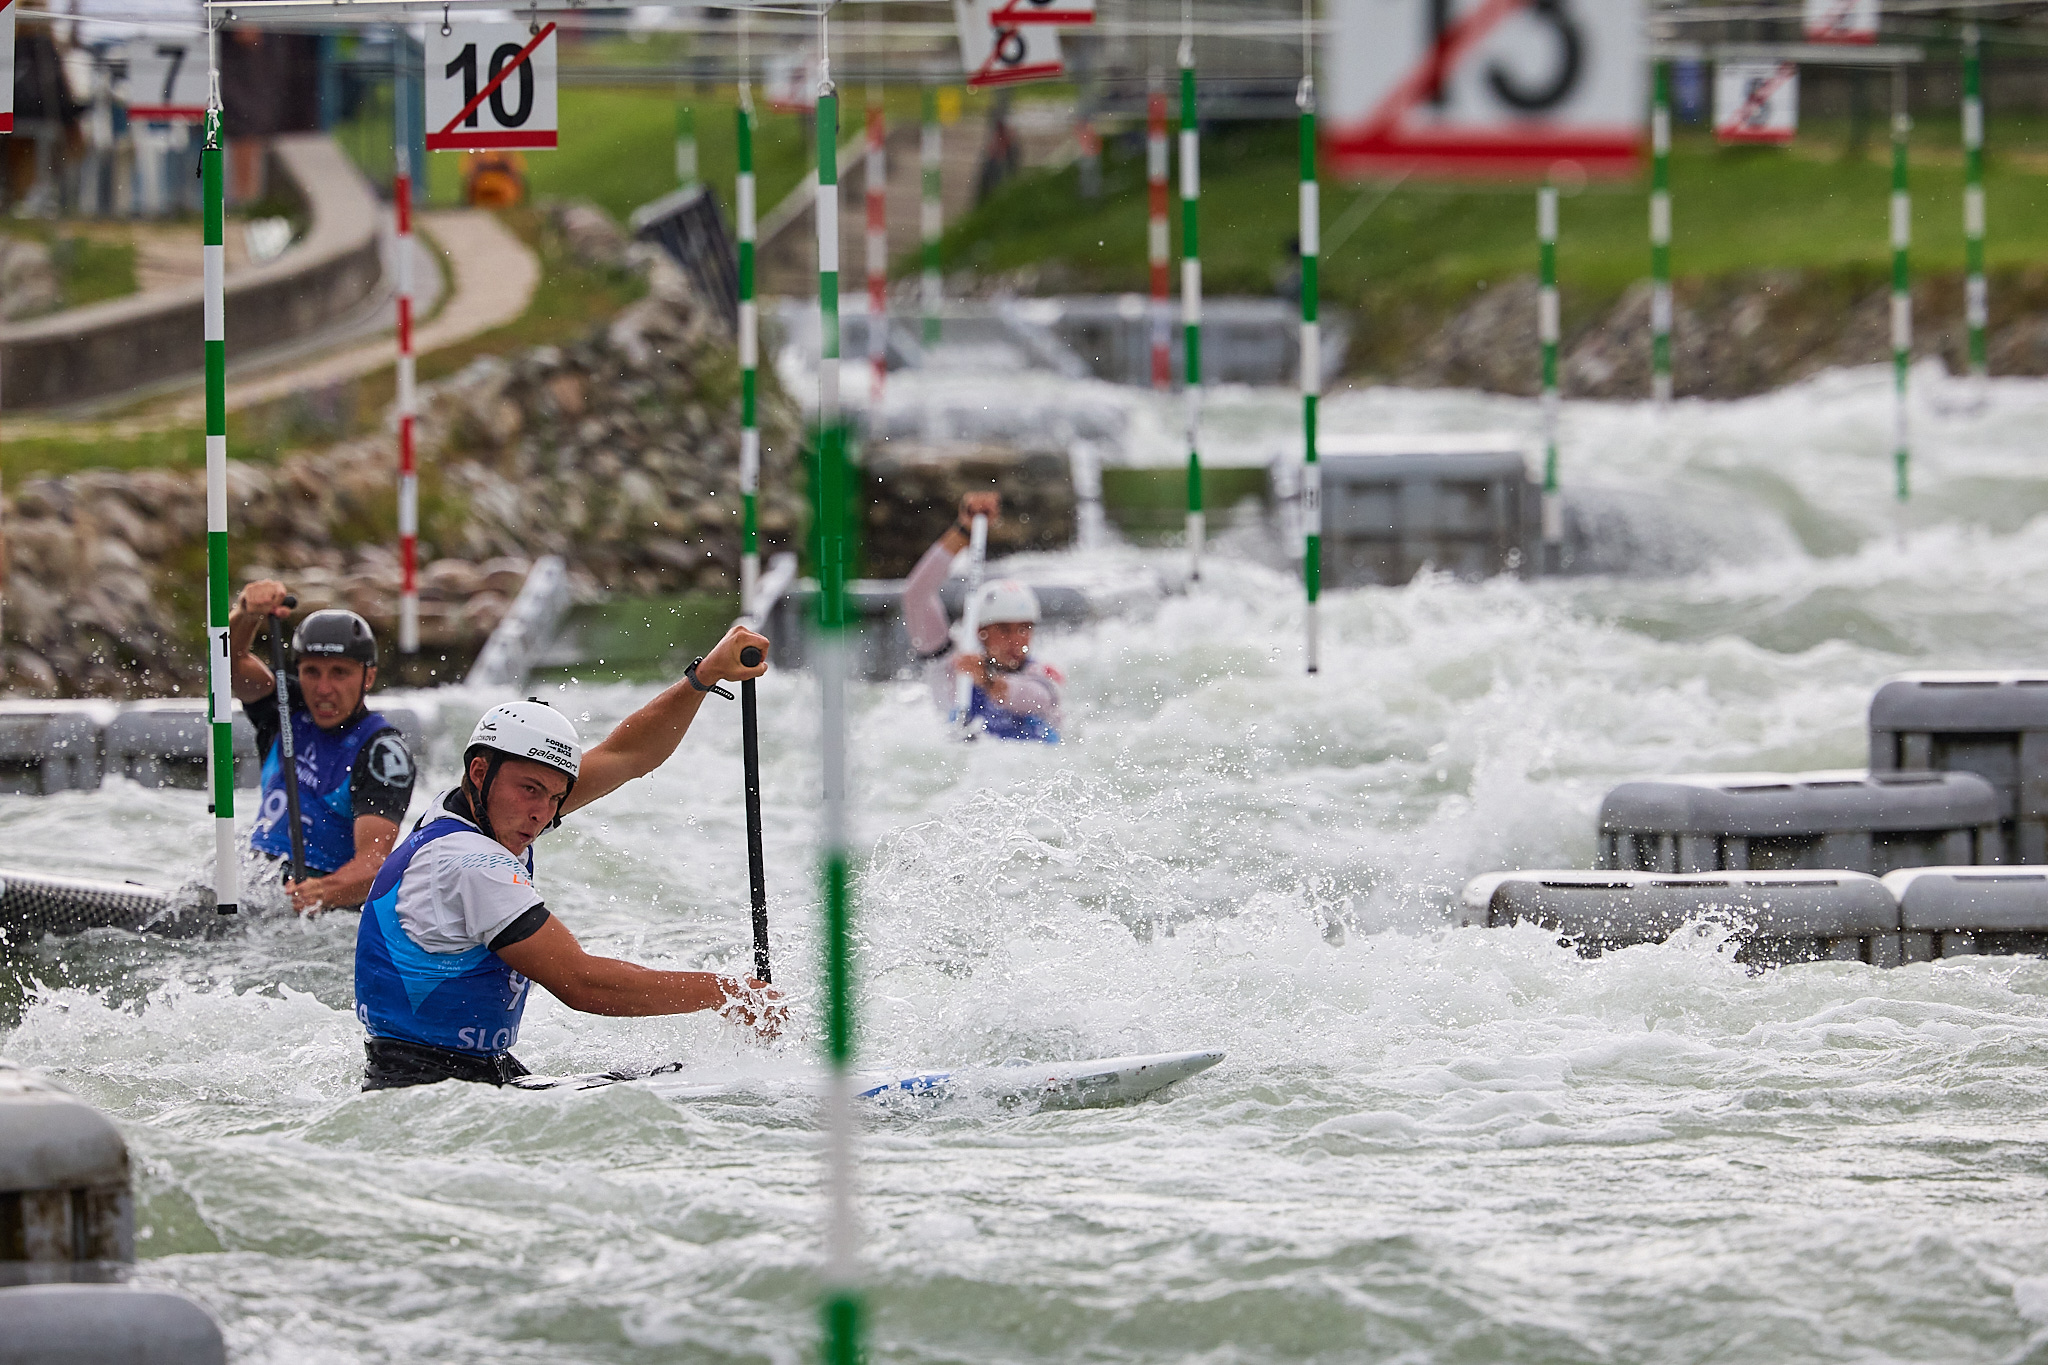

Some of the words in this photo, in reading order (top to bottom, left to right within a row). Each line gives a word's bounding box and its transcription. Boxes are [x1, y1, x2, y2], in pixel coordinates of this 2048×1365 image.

[156, 44, 186, 102] 7
[1412, 0, 1583, 114] 13
[446, 43, 534, 128] 10
[219, 631, 230, 657] 1
[526, 747, 578, 773] galasport
[507, 970, 529, 1010] 9
